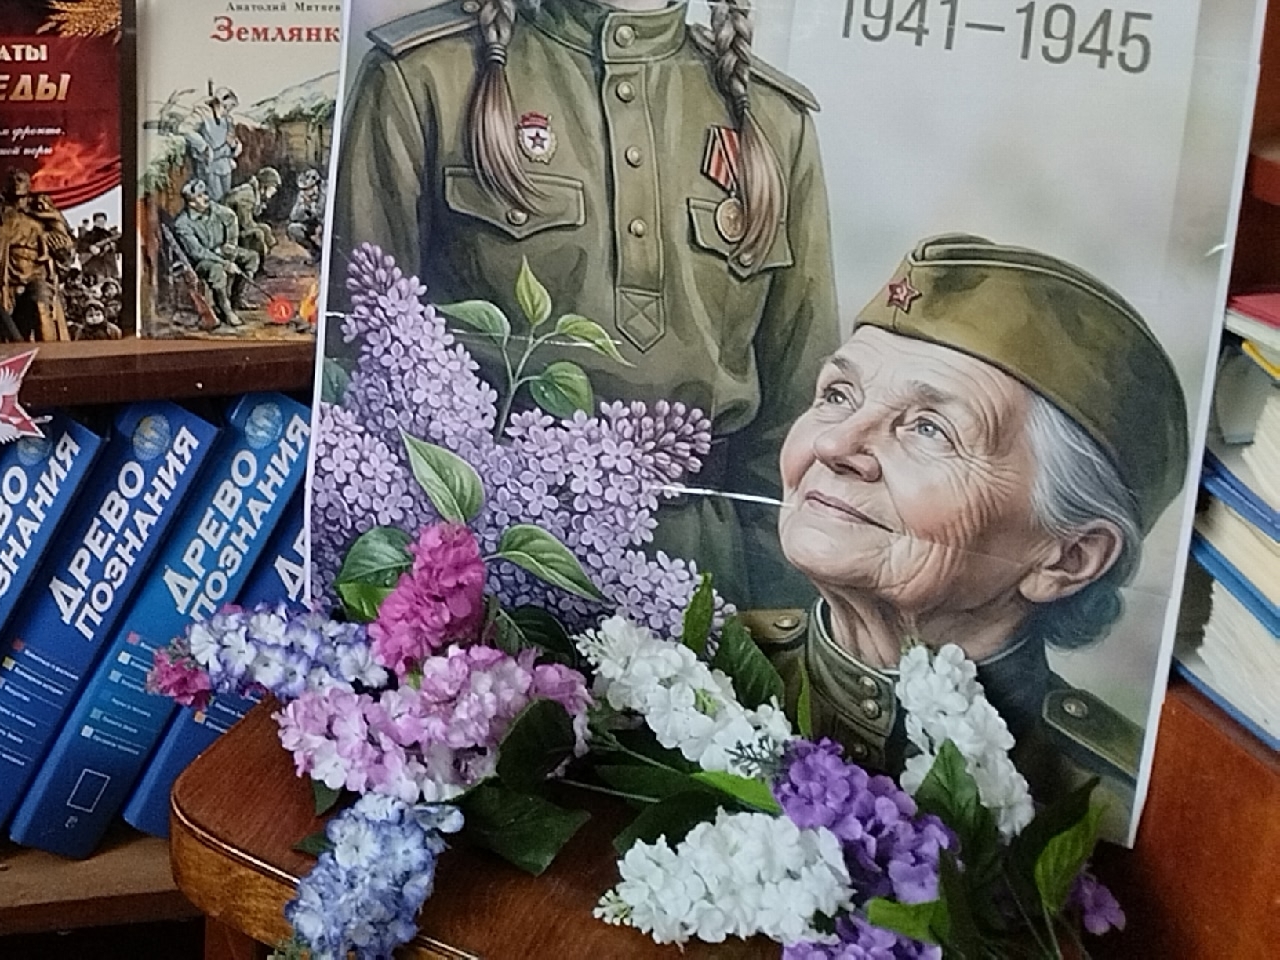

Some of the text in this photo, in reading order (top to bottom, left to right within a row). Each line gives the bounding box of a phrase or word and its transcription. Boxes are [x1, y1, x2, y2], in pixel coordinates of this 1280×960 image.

[226, 1, 341, 12] Анатолий Митяев
[49, 461, 145, 625] ДРЕВО
[74, 426, 200, 641] ПОЗНАНИЯ
[162, 450, 257, 614] ДРЕВО
[190, 414, 312, 621] ПОЗНАНИЯ
